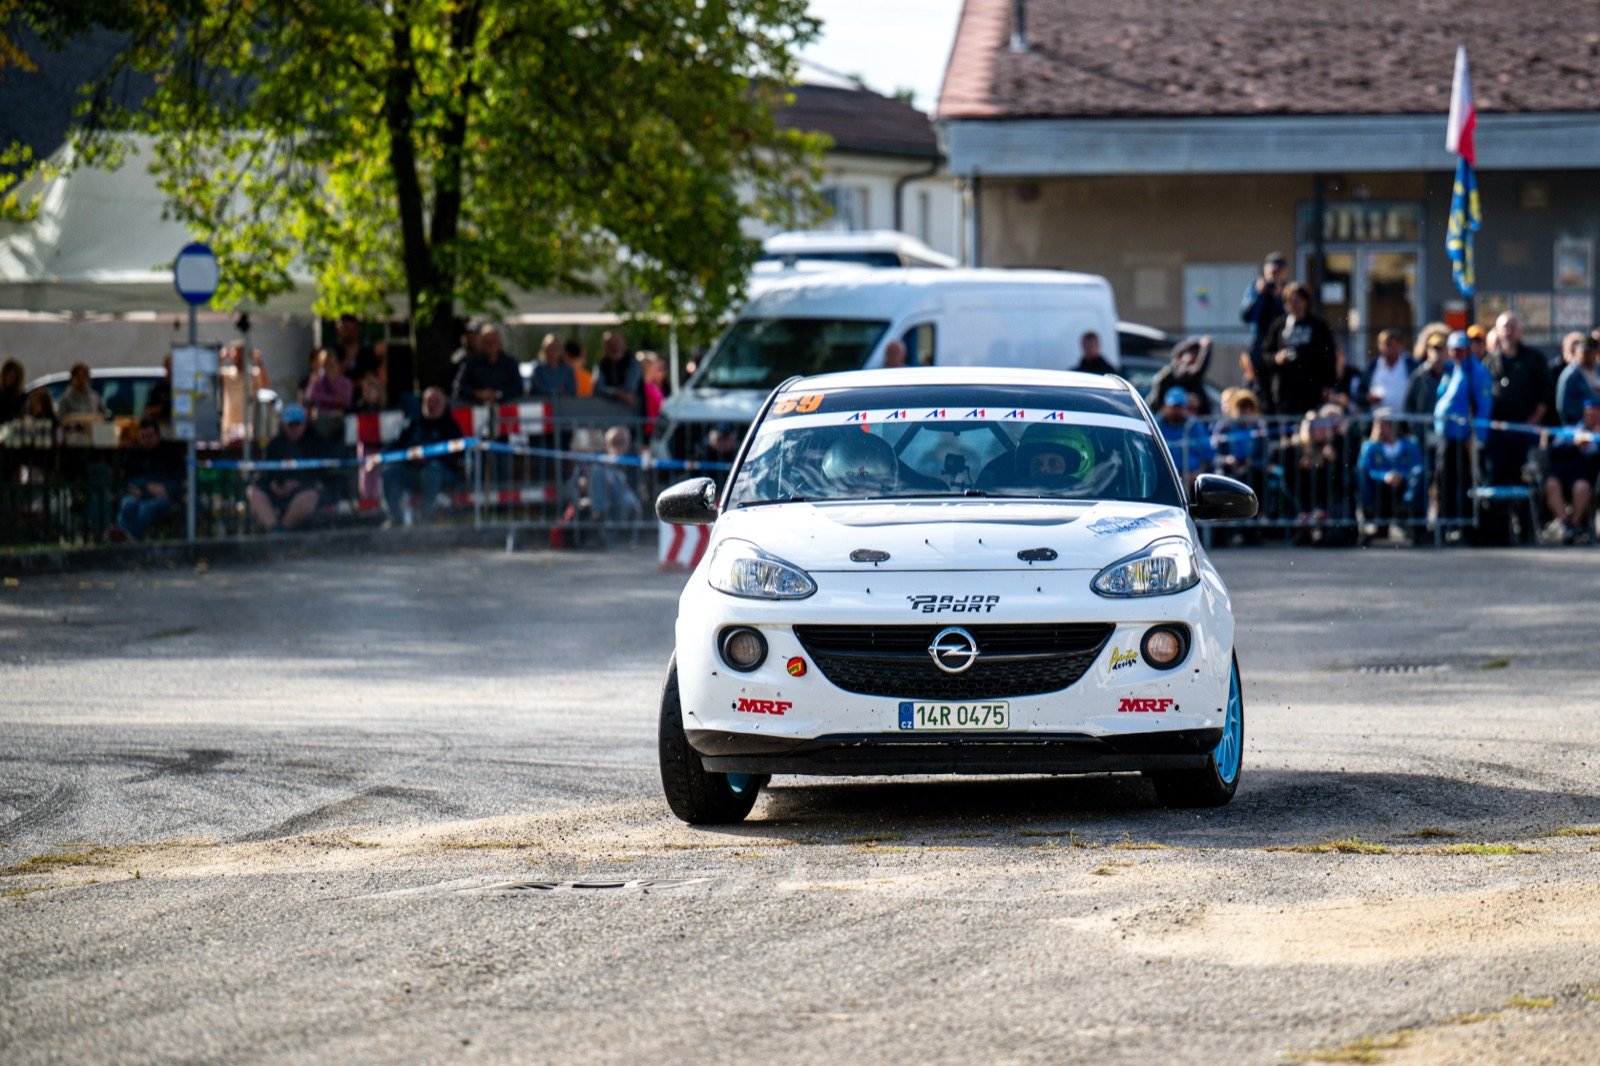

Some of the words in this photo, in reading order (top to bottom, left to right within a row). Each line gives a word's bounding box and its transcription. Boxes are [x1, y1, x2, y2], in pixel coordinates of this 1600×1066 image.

[773, 393, 825, 415] 69
[922, 604, 997, 613] SPORT
[737, 698, 793, 715] MRF
[1118, 698, 1173, 713] MRF
[916, 705, 952, 726] 14R
[957, 705, 1005, 726] 0475
[901, 720, 913, 729] CZ
